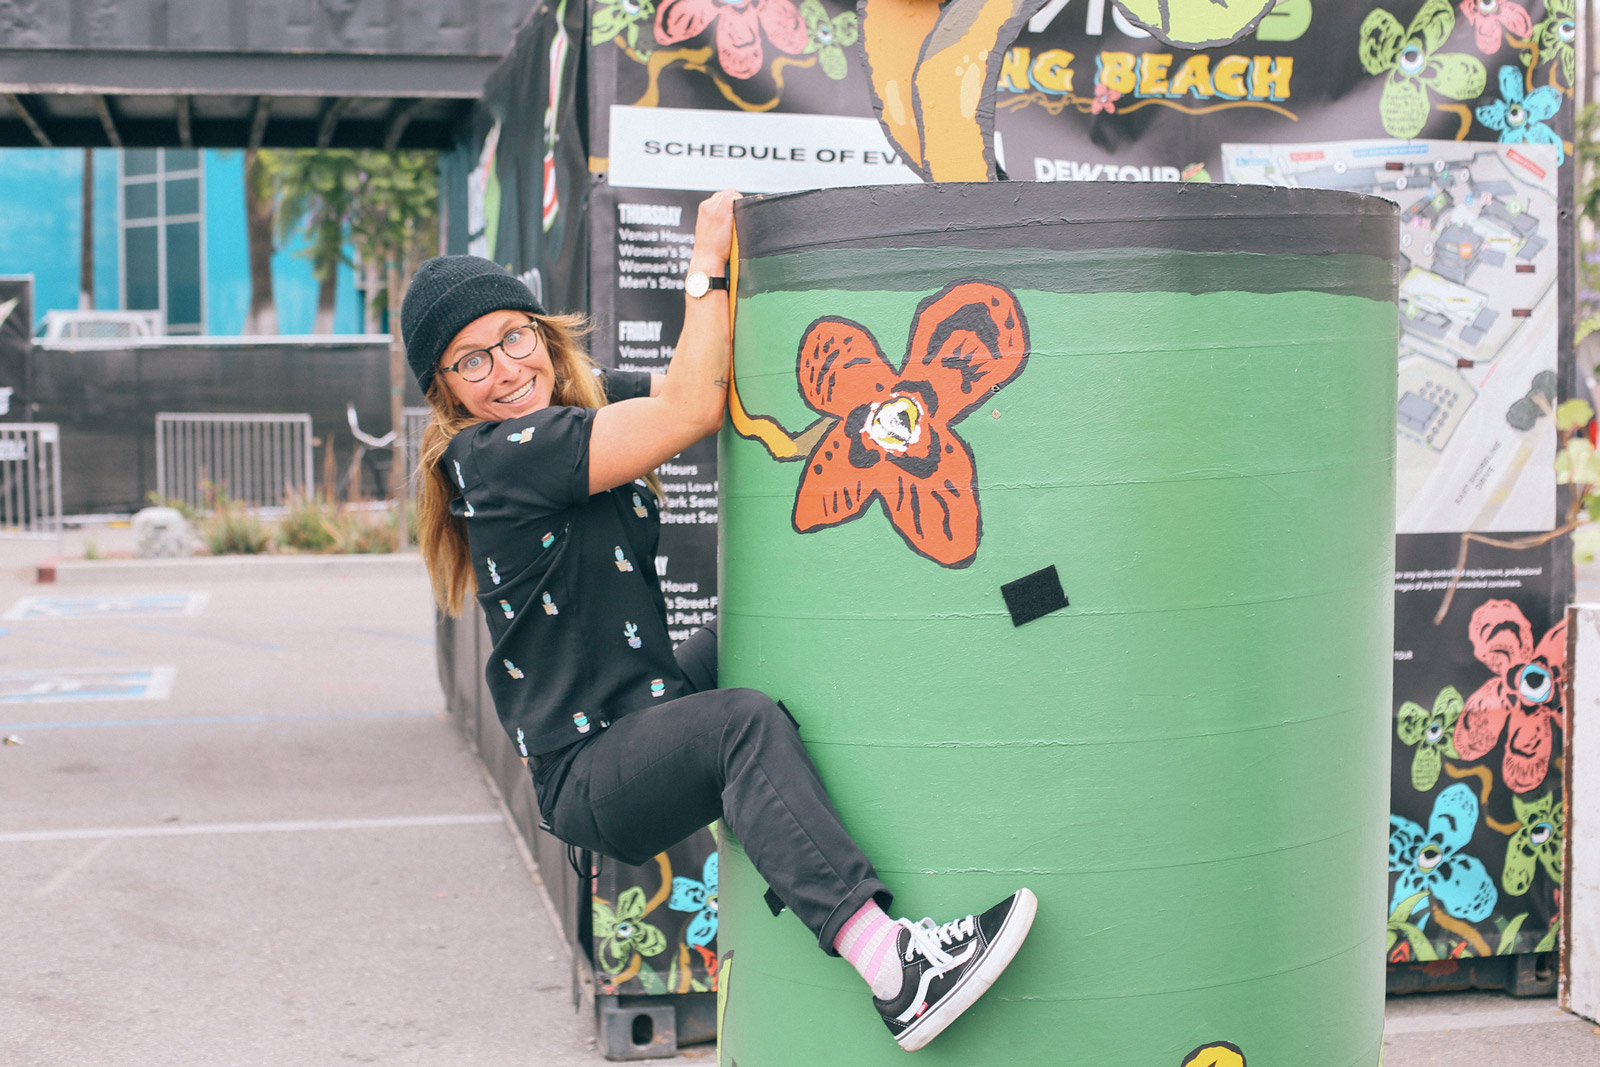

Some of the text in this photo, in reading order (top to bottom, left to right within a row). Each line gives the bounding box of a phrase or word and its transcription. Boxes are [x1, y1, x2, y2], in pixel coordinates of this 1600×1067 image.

[998, 47, 1294, 100] NG BEACH
[644, 140, 904, 165] SCHEDULE OF EV
[618, 203, 682, 226] THURSDAY
[618, 228, 695, 244] Venue Hours
[618, 244, 678, 258] Women's
[618, 259, 678, 274] Women's
[619, 275, 685, 290] Men's Stre
[618, 321, 663, 342] FRIDAY
[618, 345, 659, 359] Venue
[660, 463, 698, 476] Hours
[688, 481, 713, 493] Love
[659, 510, 697, 524] Street
[660, 580, 698, 593] Hours
[675, 596, 710, 610] Street
[675, 612, 701, 625] Park
